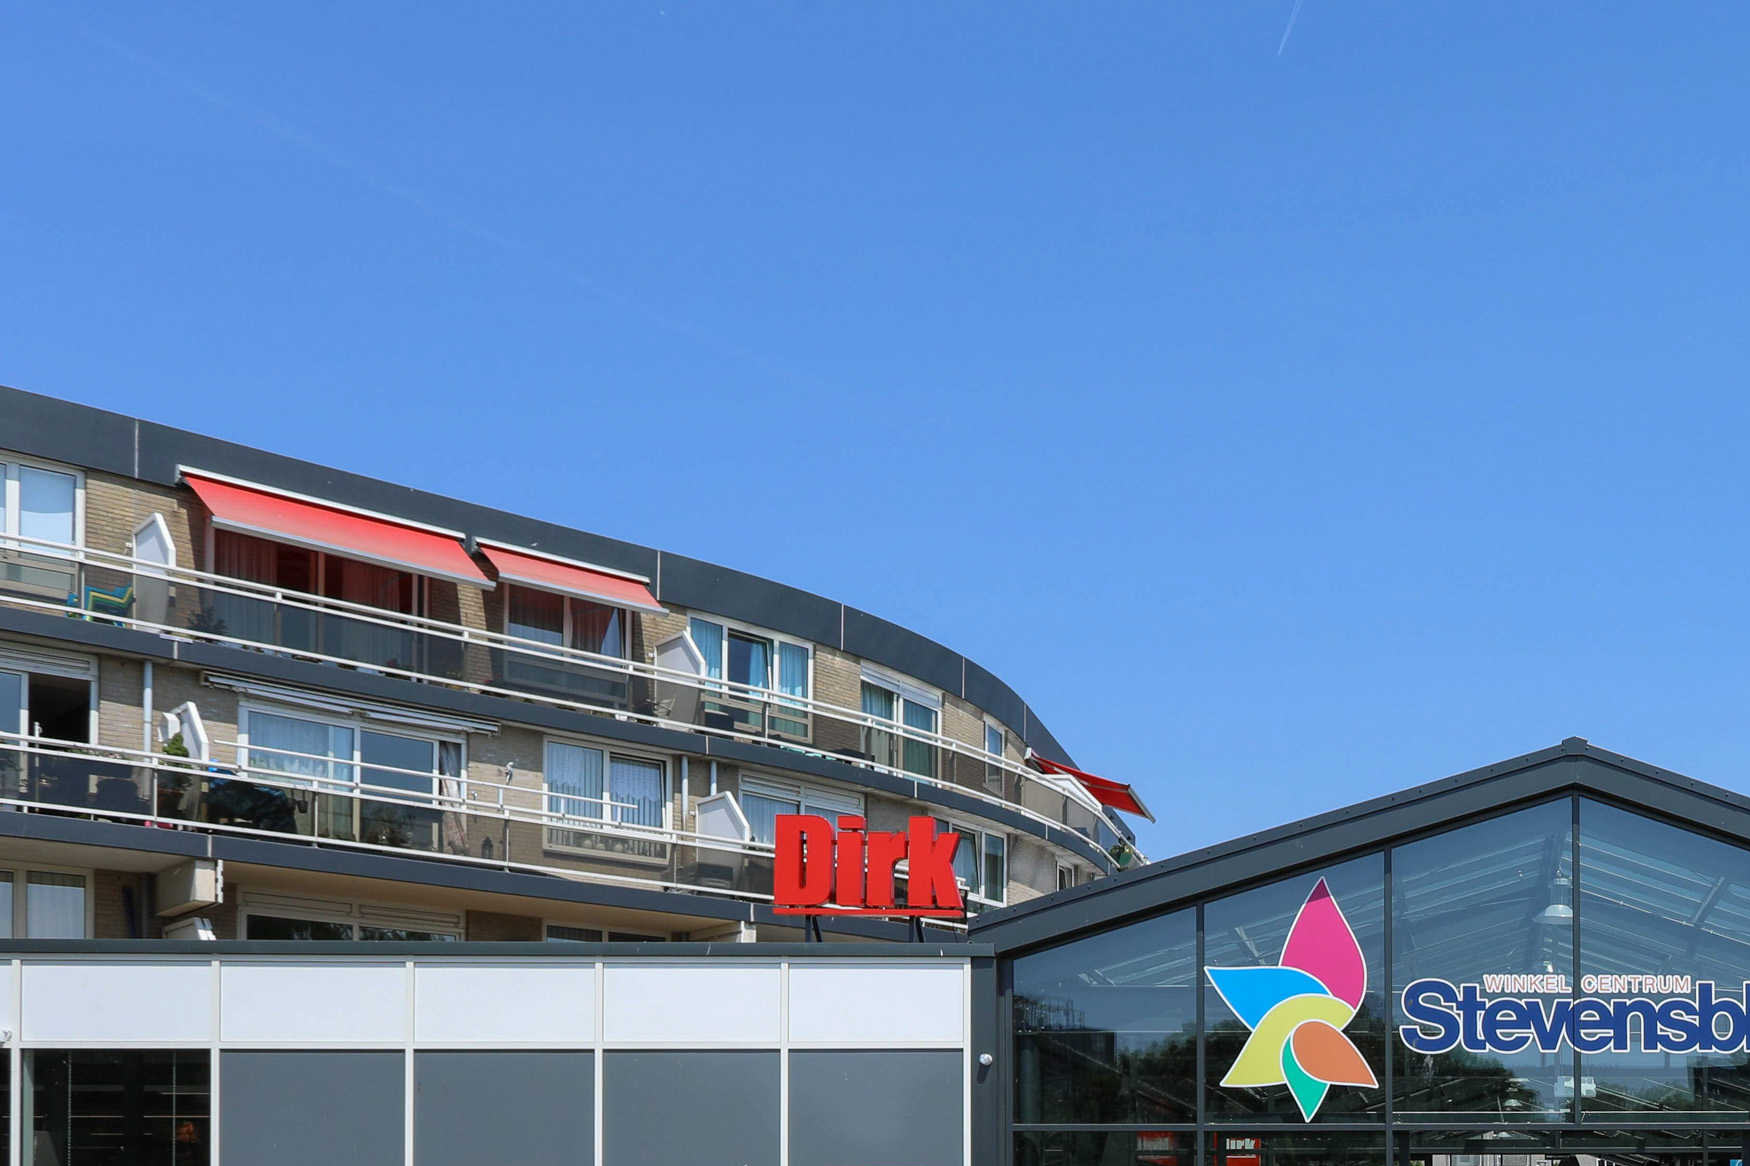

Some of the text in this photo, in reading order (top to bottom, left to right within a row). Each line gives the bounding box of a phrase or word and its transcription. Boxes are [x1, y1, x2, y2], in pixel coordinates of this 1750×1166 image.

[774, 814, 964, 908] Dirk
[1483, 974, 1692, 994] WINKEL CENTRUM
